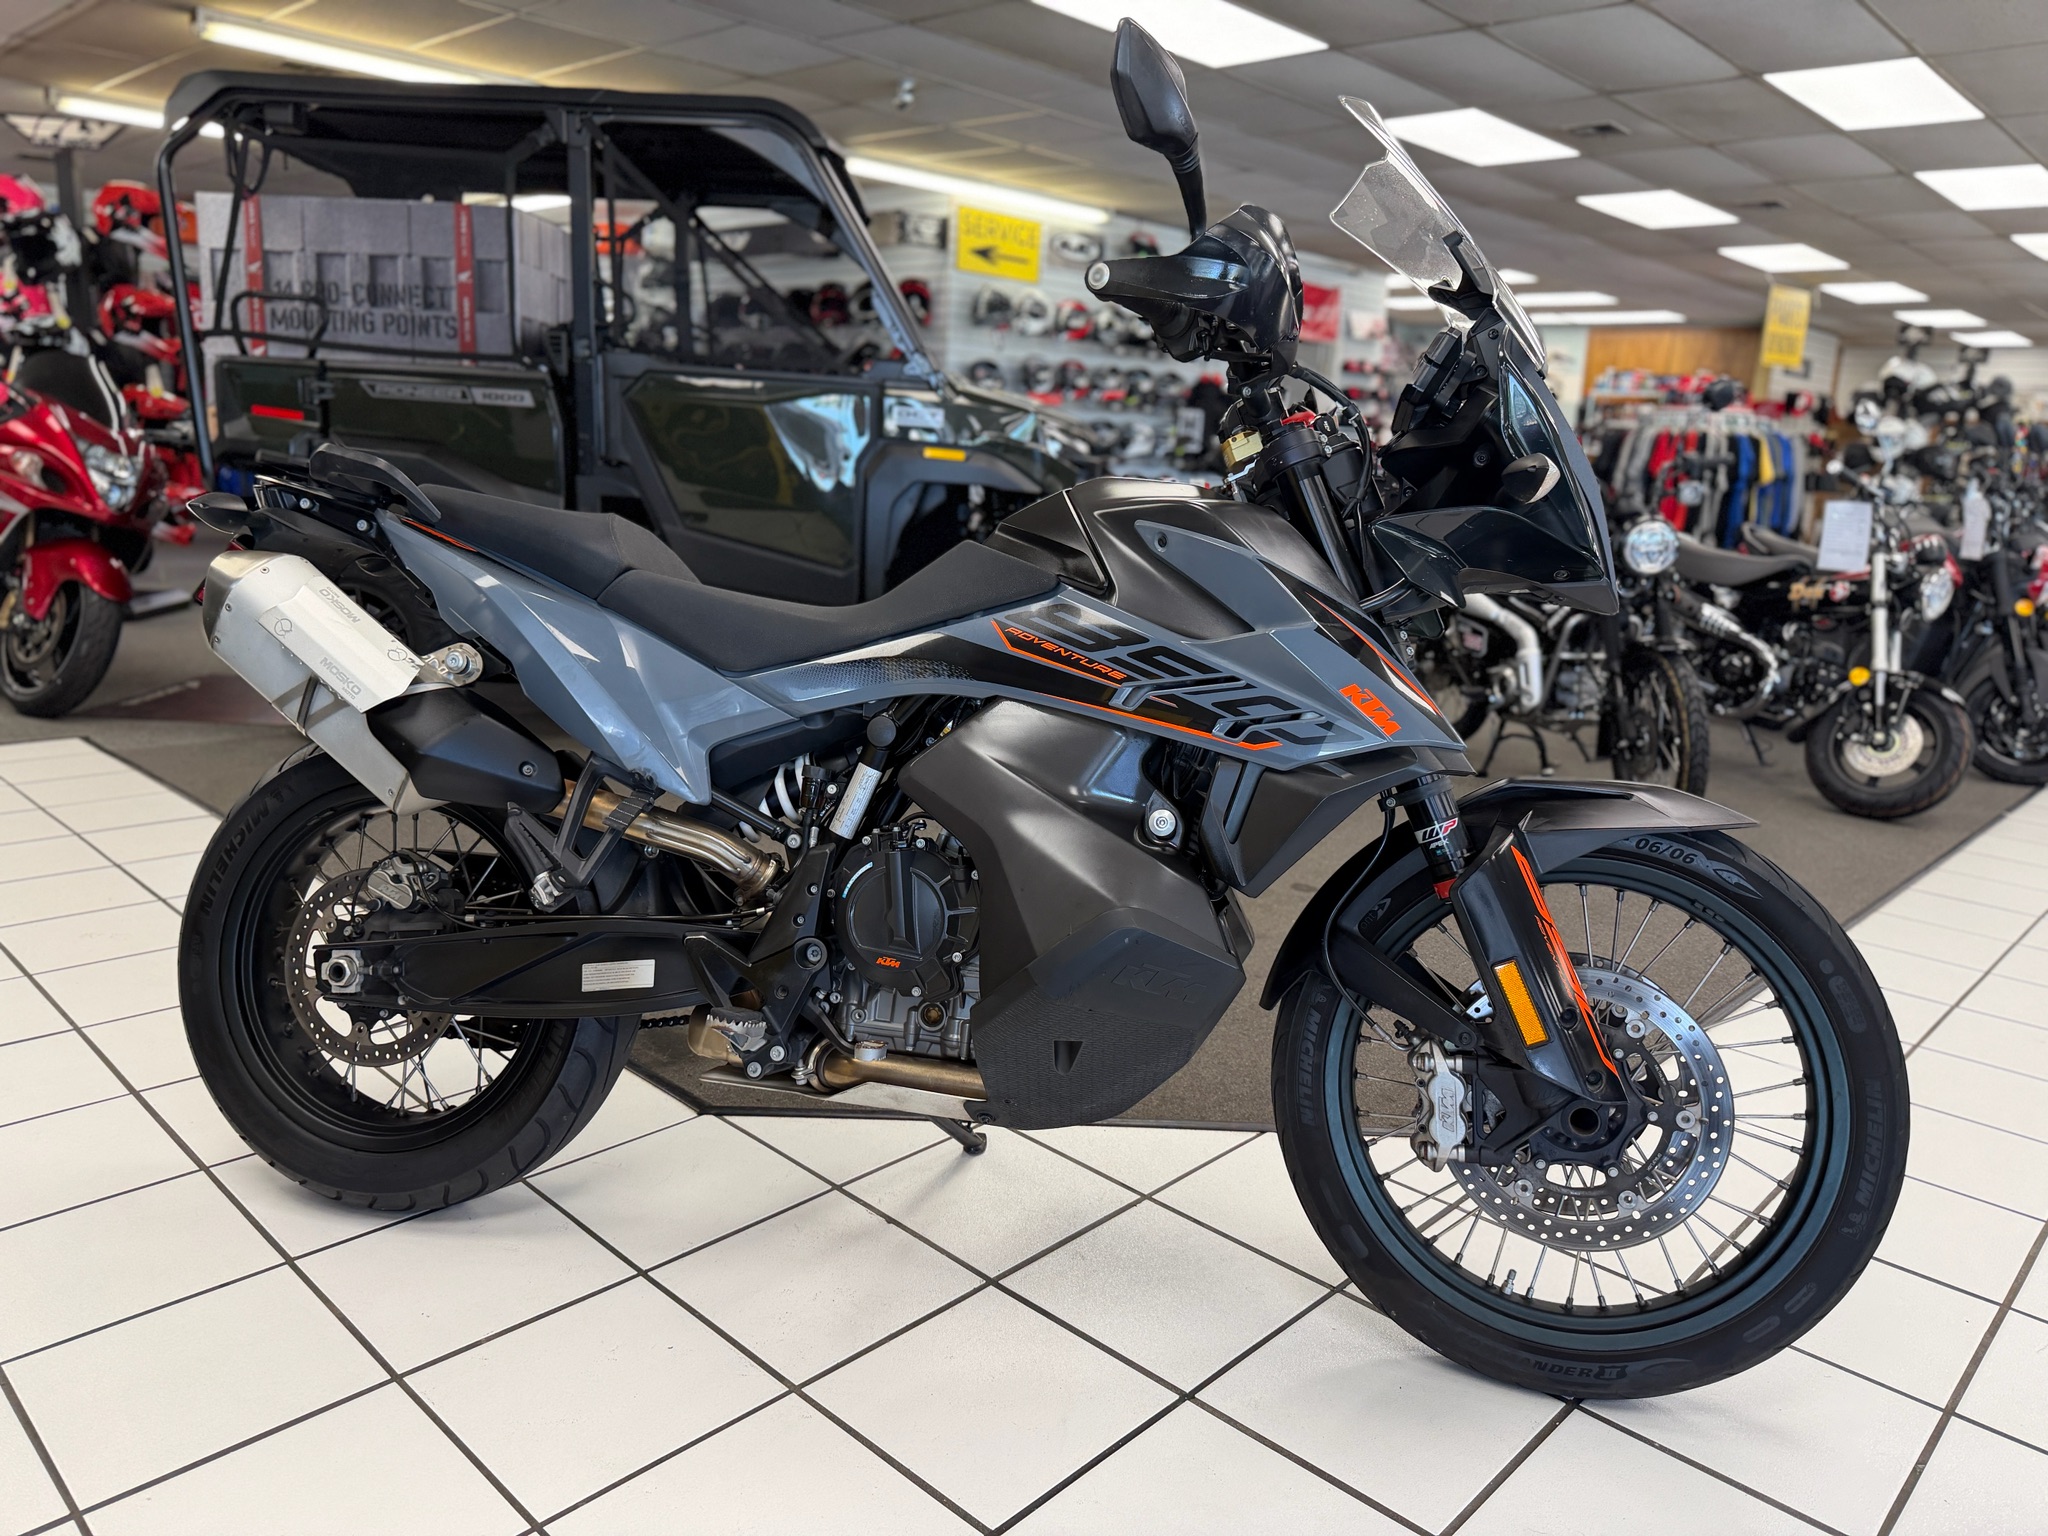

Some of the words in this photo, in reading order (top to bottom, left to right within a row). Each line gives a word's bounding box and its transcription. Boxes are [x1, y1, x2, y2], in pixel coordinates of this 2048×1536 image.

[962, 213, 1037, 248] SERVICE
[270, 308, 374, 335] MOUTING
[382, 311, 458, 340] POINTS
[481, 392, 525, 403] 1000
[319, 588, 360, 624] MOSKO
[1004, 626, 1127, 681] ADVENTURE
[319, 656, 362, 697] MOSKO
[1339, 684, 1402, 738] KTM
[200, 801, 271, 916] MICHELIN
[876, 956, 901, 968] KTM
[1110, 963, 1208, 1004] KTM
[1298, 1007, 1322, 1126] MICHELIN
[1438, 1087, 1455, 1133] KTM
[1854, 1077, 1885, 1205] MICHELIN
